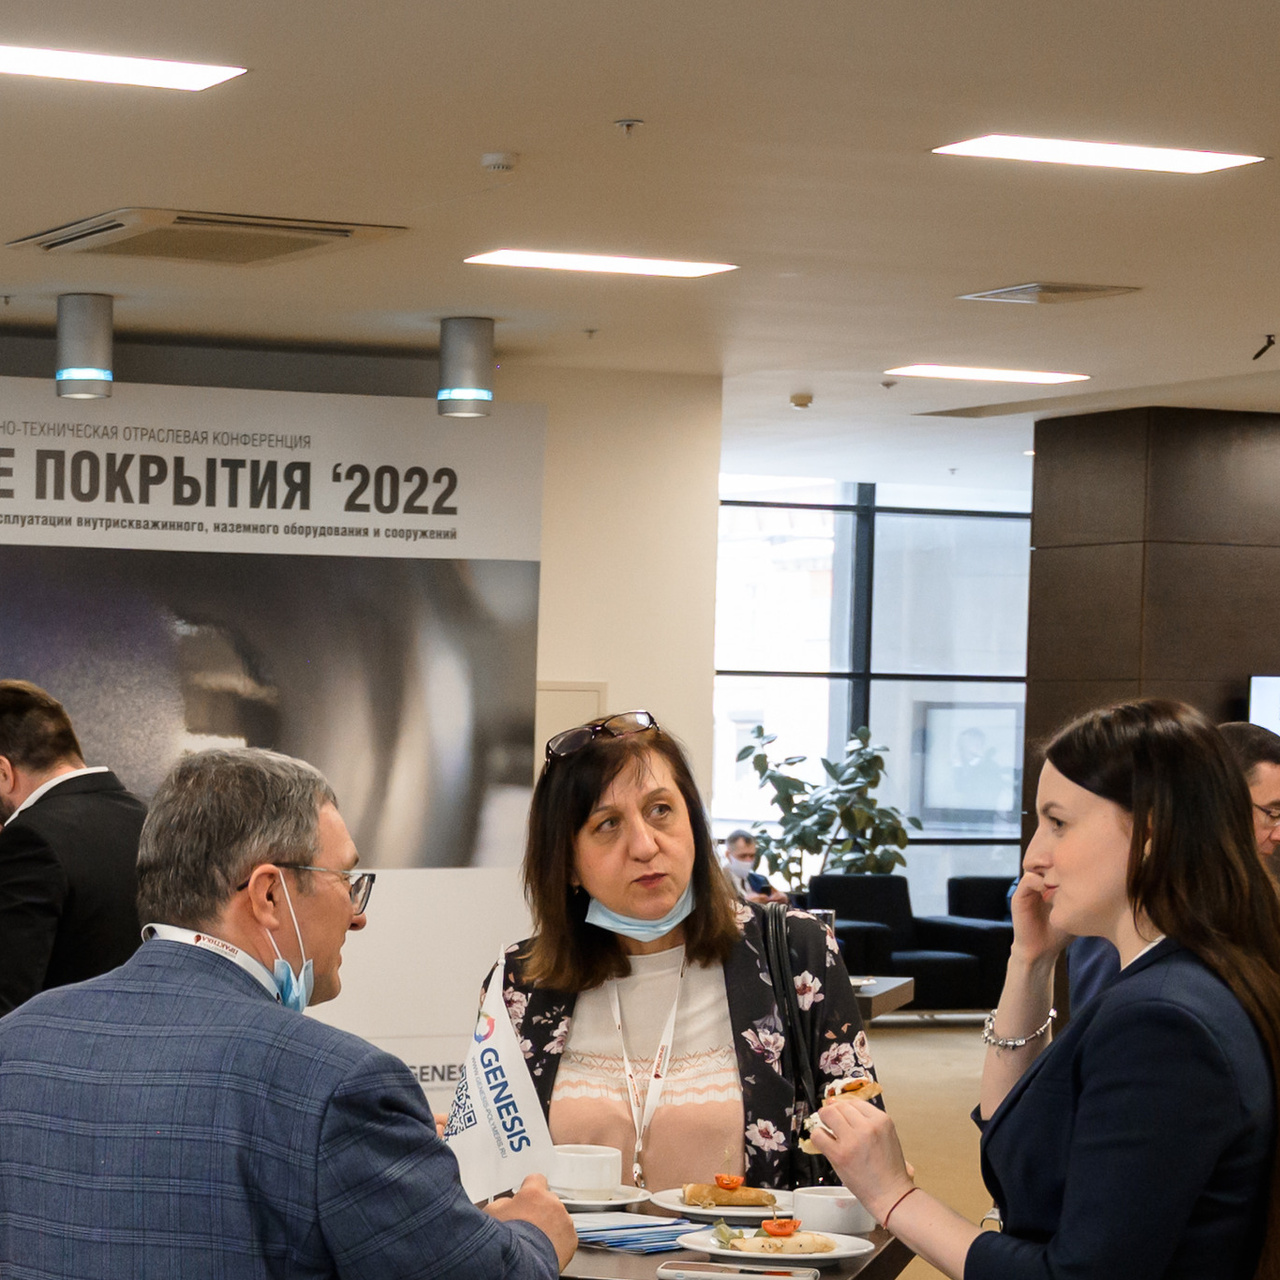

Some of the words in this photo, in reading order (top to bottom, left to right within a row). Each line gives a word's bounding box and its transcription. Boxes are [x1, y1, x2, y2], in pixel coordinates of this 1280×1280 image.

[122, 426, 209, 445] ОТРАСЛЕВАЯ
[212, 431, 311, 451] КОНФЕРЕНЦИЯ
[35, 450, 311, 511] ПОКРЫТИЯ
[76, 517, 208, 533] внутрискважинного,
[213, 523, 279, 535] наземного
[283, 522, 369, 538] оборудования
[373, 530, 380, 538] и
[384, 527, 458, 541] сооружений
[480, 1047, 531, 1153] GENESIS
